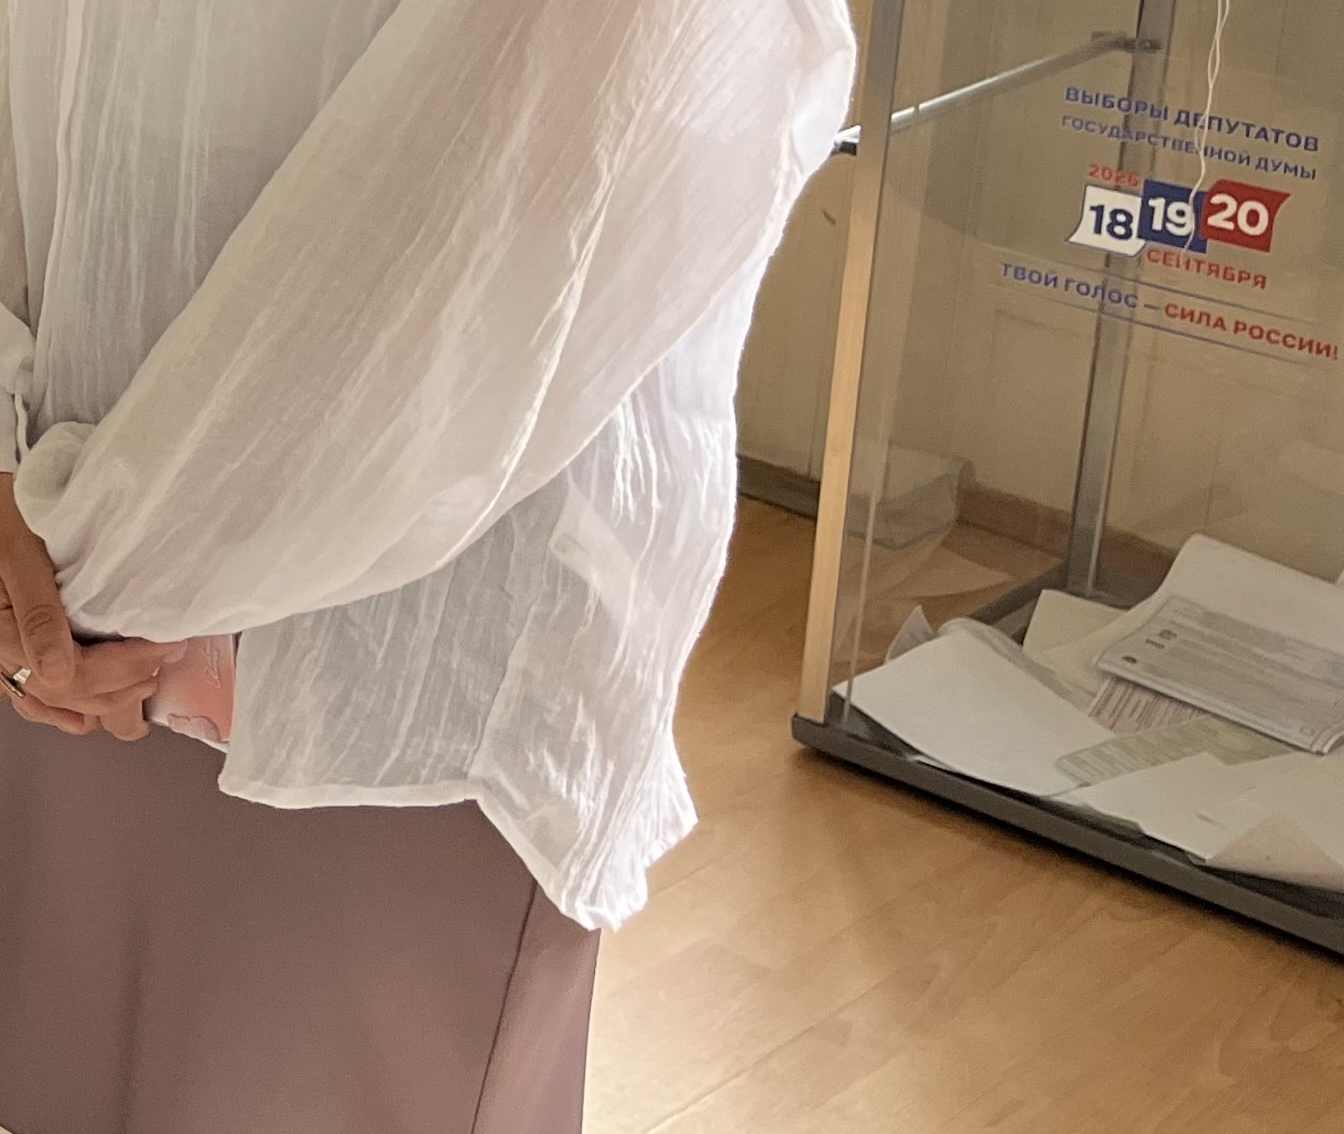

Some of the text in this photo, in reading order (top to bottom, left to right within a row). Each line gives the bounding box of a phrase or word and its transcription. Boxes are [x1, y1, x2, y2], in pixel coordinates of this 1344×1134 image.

[1061, 115, 1317, 180] ГОСУДАРСТВЕННОЙ ДУМЫ
[1065, 87, 1319, 153] ВЫБОРЫ ДЕПУТАТОВ
[1088, 163, 1141, 188] 2026
[1089, 193, 1269, 240] 18 19 20
[1146, 248, 1268, 289] СЕНТЯБРЯ
[1064, 278, 1138, 308] ГОЛОС
[1164, 303, 1227, 331] СИЛА
[1233, 321, 1340, 361] РОССИИ!
